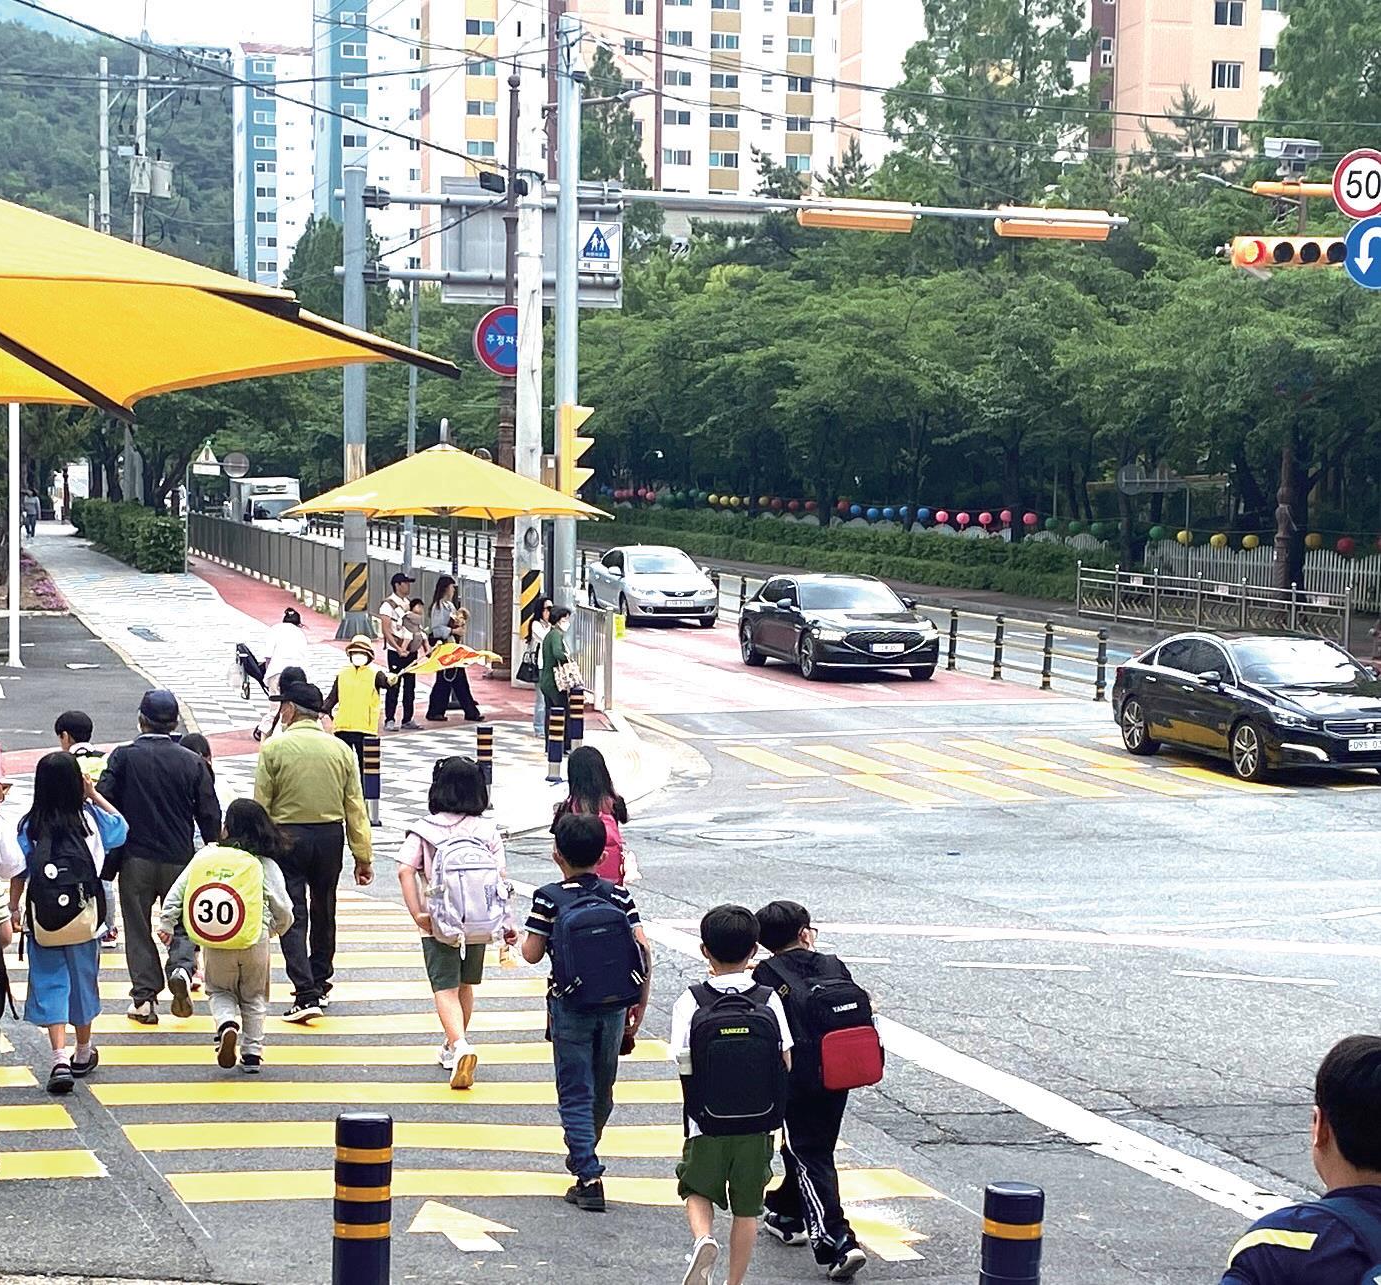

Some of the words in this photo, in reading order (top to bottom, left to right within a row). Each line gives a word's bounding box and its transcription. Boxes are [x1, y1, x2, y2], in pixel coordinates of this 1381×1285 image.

[1346, 170, 1381, 199] 50
[486, 334, 517, 346] 주정차
[198, 899, 234, 925] 30
